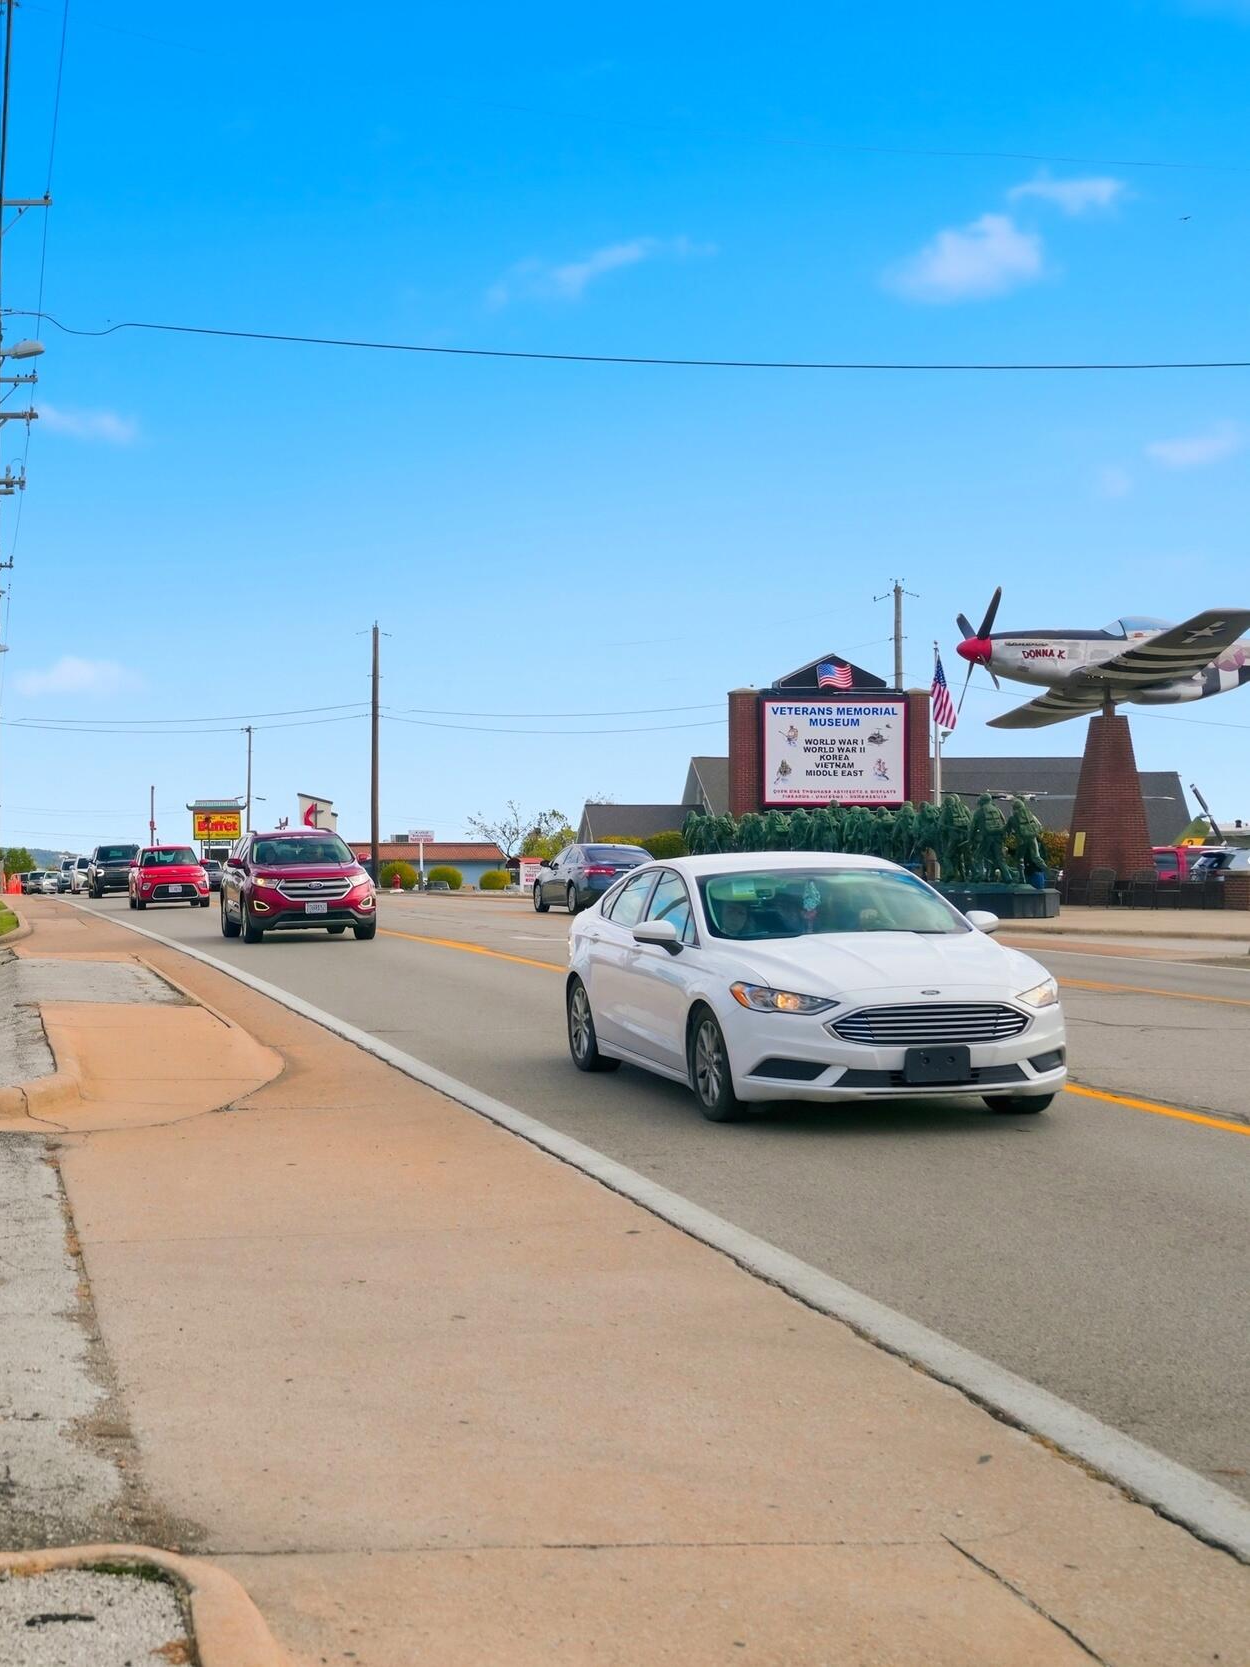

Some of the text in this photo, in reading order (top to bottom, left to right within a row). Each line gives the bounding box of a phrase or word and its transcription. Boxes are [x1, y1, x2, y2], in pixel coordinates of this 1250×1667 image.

[1022, 649, 1066, 660] DONNA K
[771, 706, 898, 716] VETERANS MEMORIAL
[808, 718, 861, 727] MUSEUM
[804, 738, 836, 746] WORLD
[838, 738, 859, 746] WAR
[805, 769, 864, 777] MIDDLE EAST
